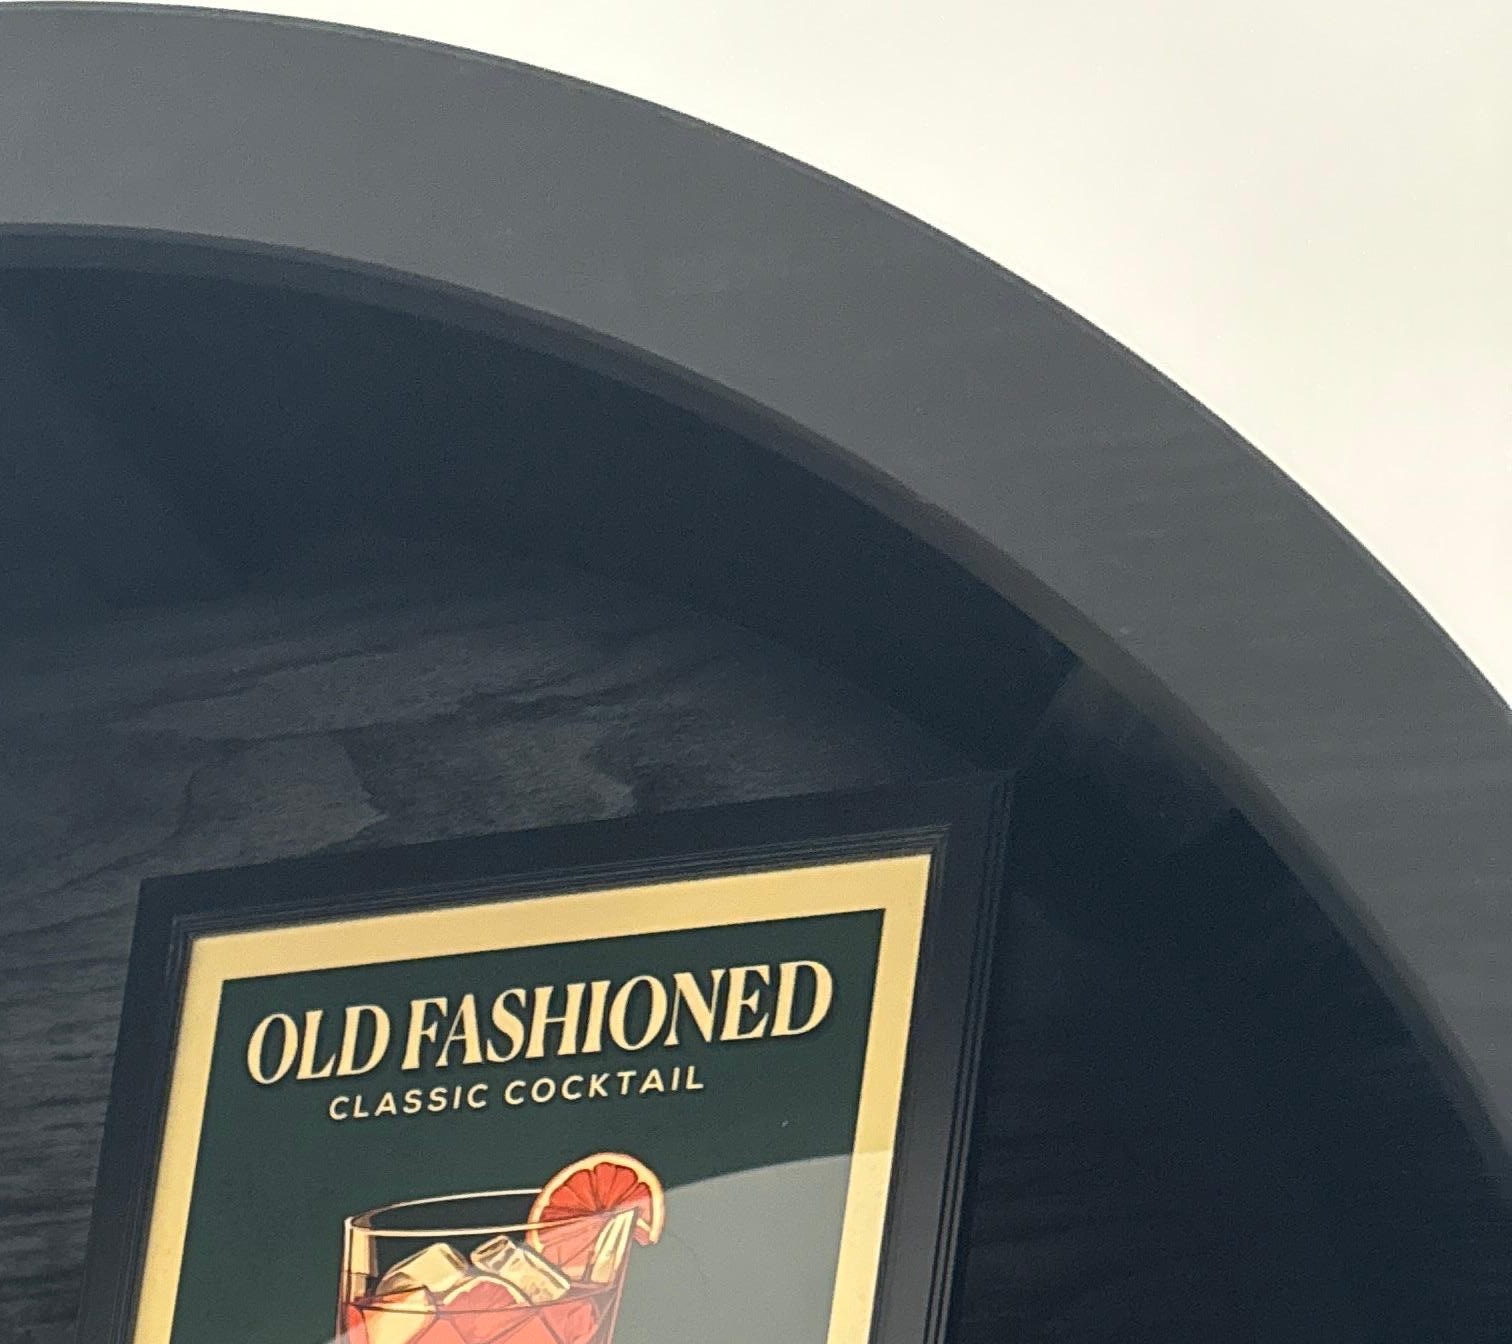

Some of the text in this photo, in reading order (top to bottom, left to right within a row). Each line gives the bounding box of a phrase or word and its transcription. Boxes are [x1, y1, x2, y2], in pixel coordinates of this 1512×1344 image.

[246, 959, 834, 1085] OLD FASHIONED
[328, 1065, 705, 1121] CLASSIC COCKTAIL
